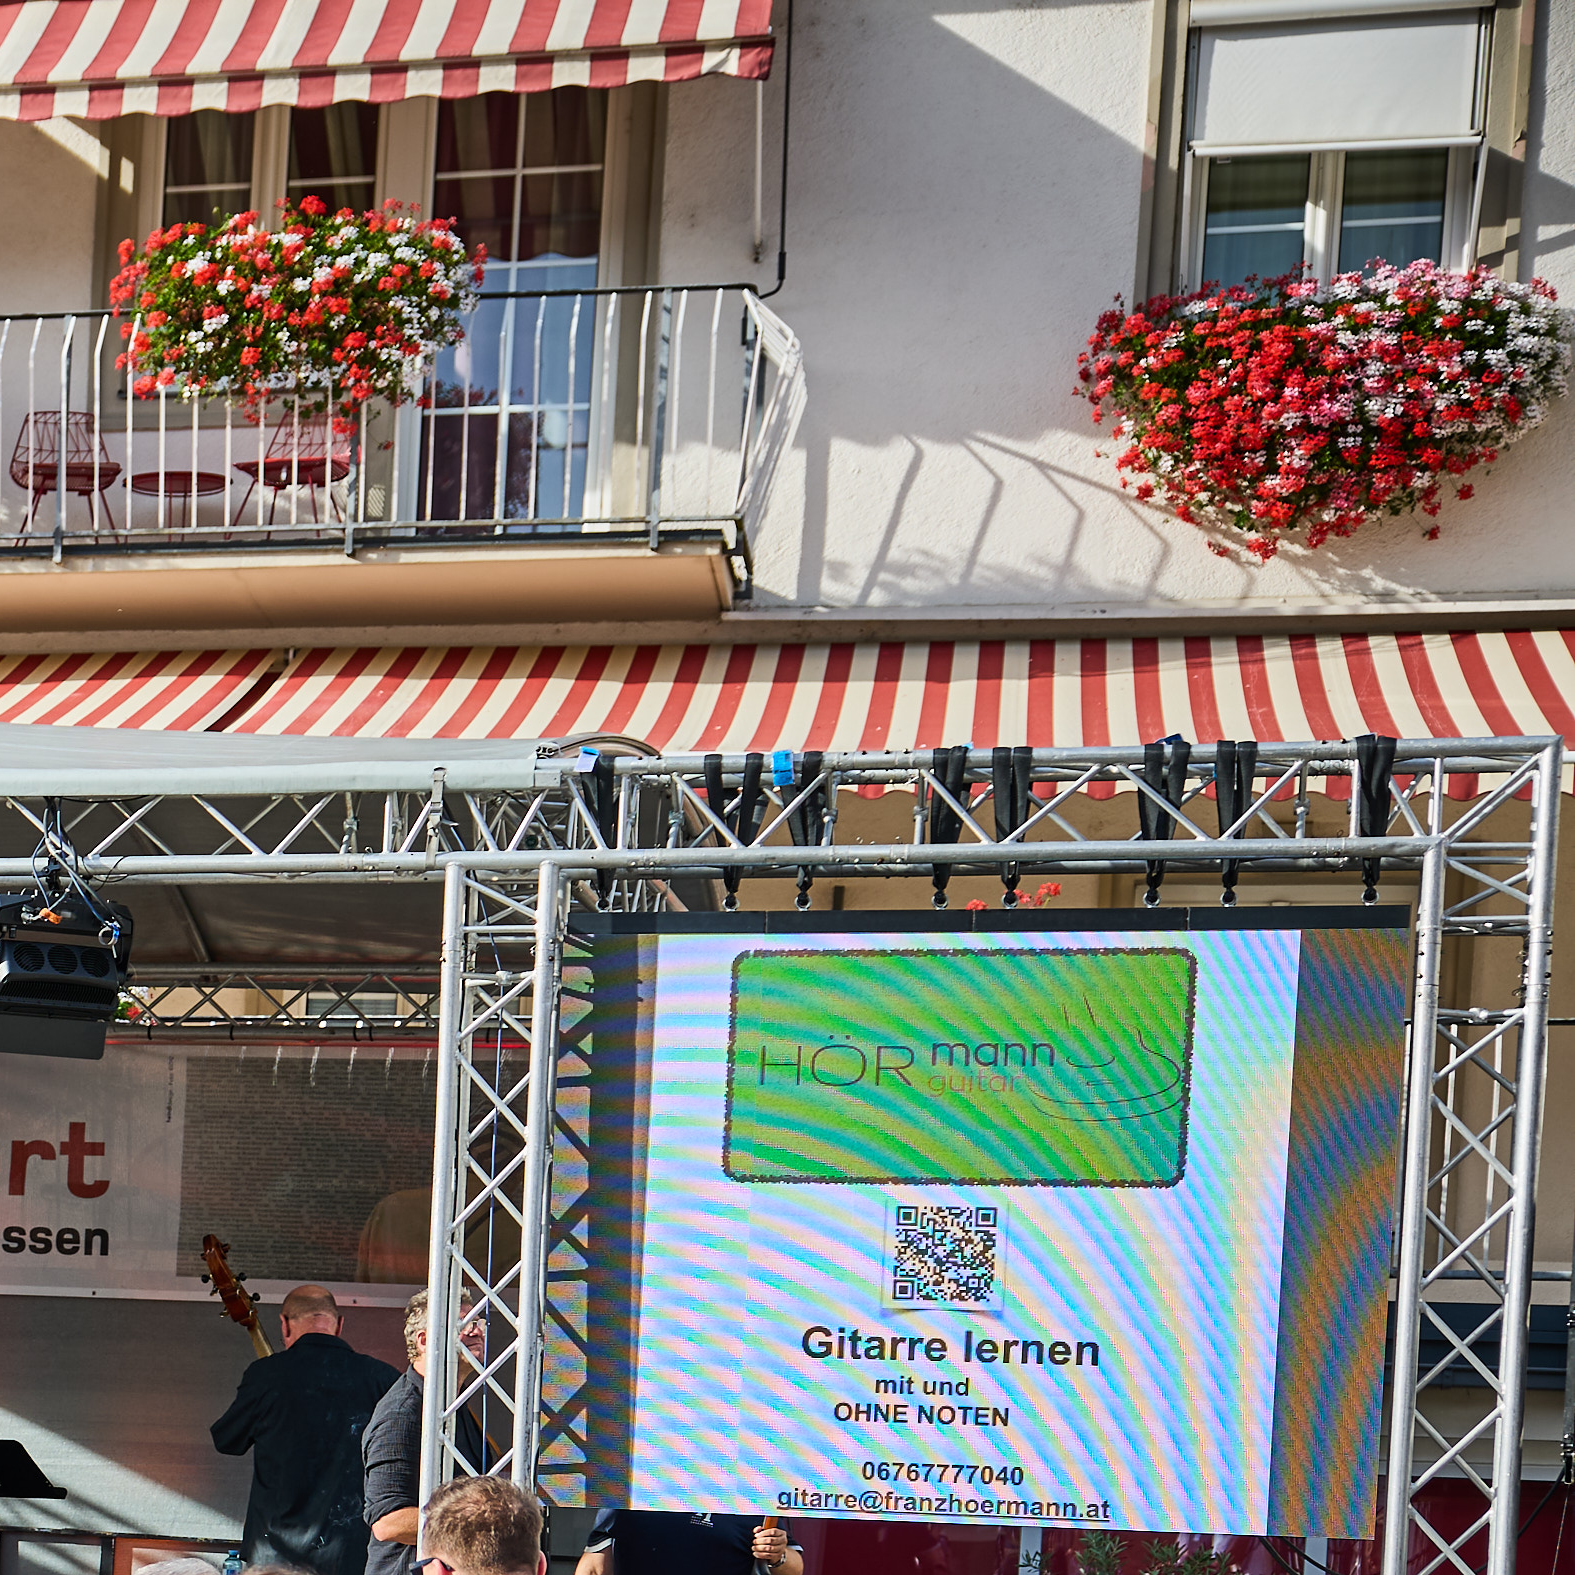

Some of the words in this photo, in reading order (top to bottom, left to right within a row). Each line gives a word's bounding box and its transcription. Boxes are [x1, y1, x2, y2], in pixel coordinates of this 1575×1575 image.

[760, 1034, 915, 1087] HÖR
[930, 1041, 1057, 1068] mann
[927, 1068, 1023, 1097] guitar
[802, 1325, 948, 1362] Gitarre
[963, 1330, 1100, 1366] lernen
[875, 1375, 914, 1396] mit
[923, 1377, 969, 1396] und
[833, 1402, 908, 1423] OHNE
[917, 1404, 1010, 1427] NOTEN
[862, 1461, 1024, 1486] 06767777040
[777, 1488, 1110, 1520] gitarre@franzhoermann.at
